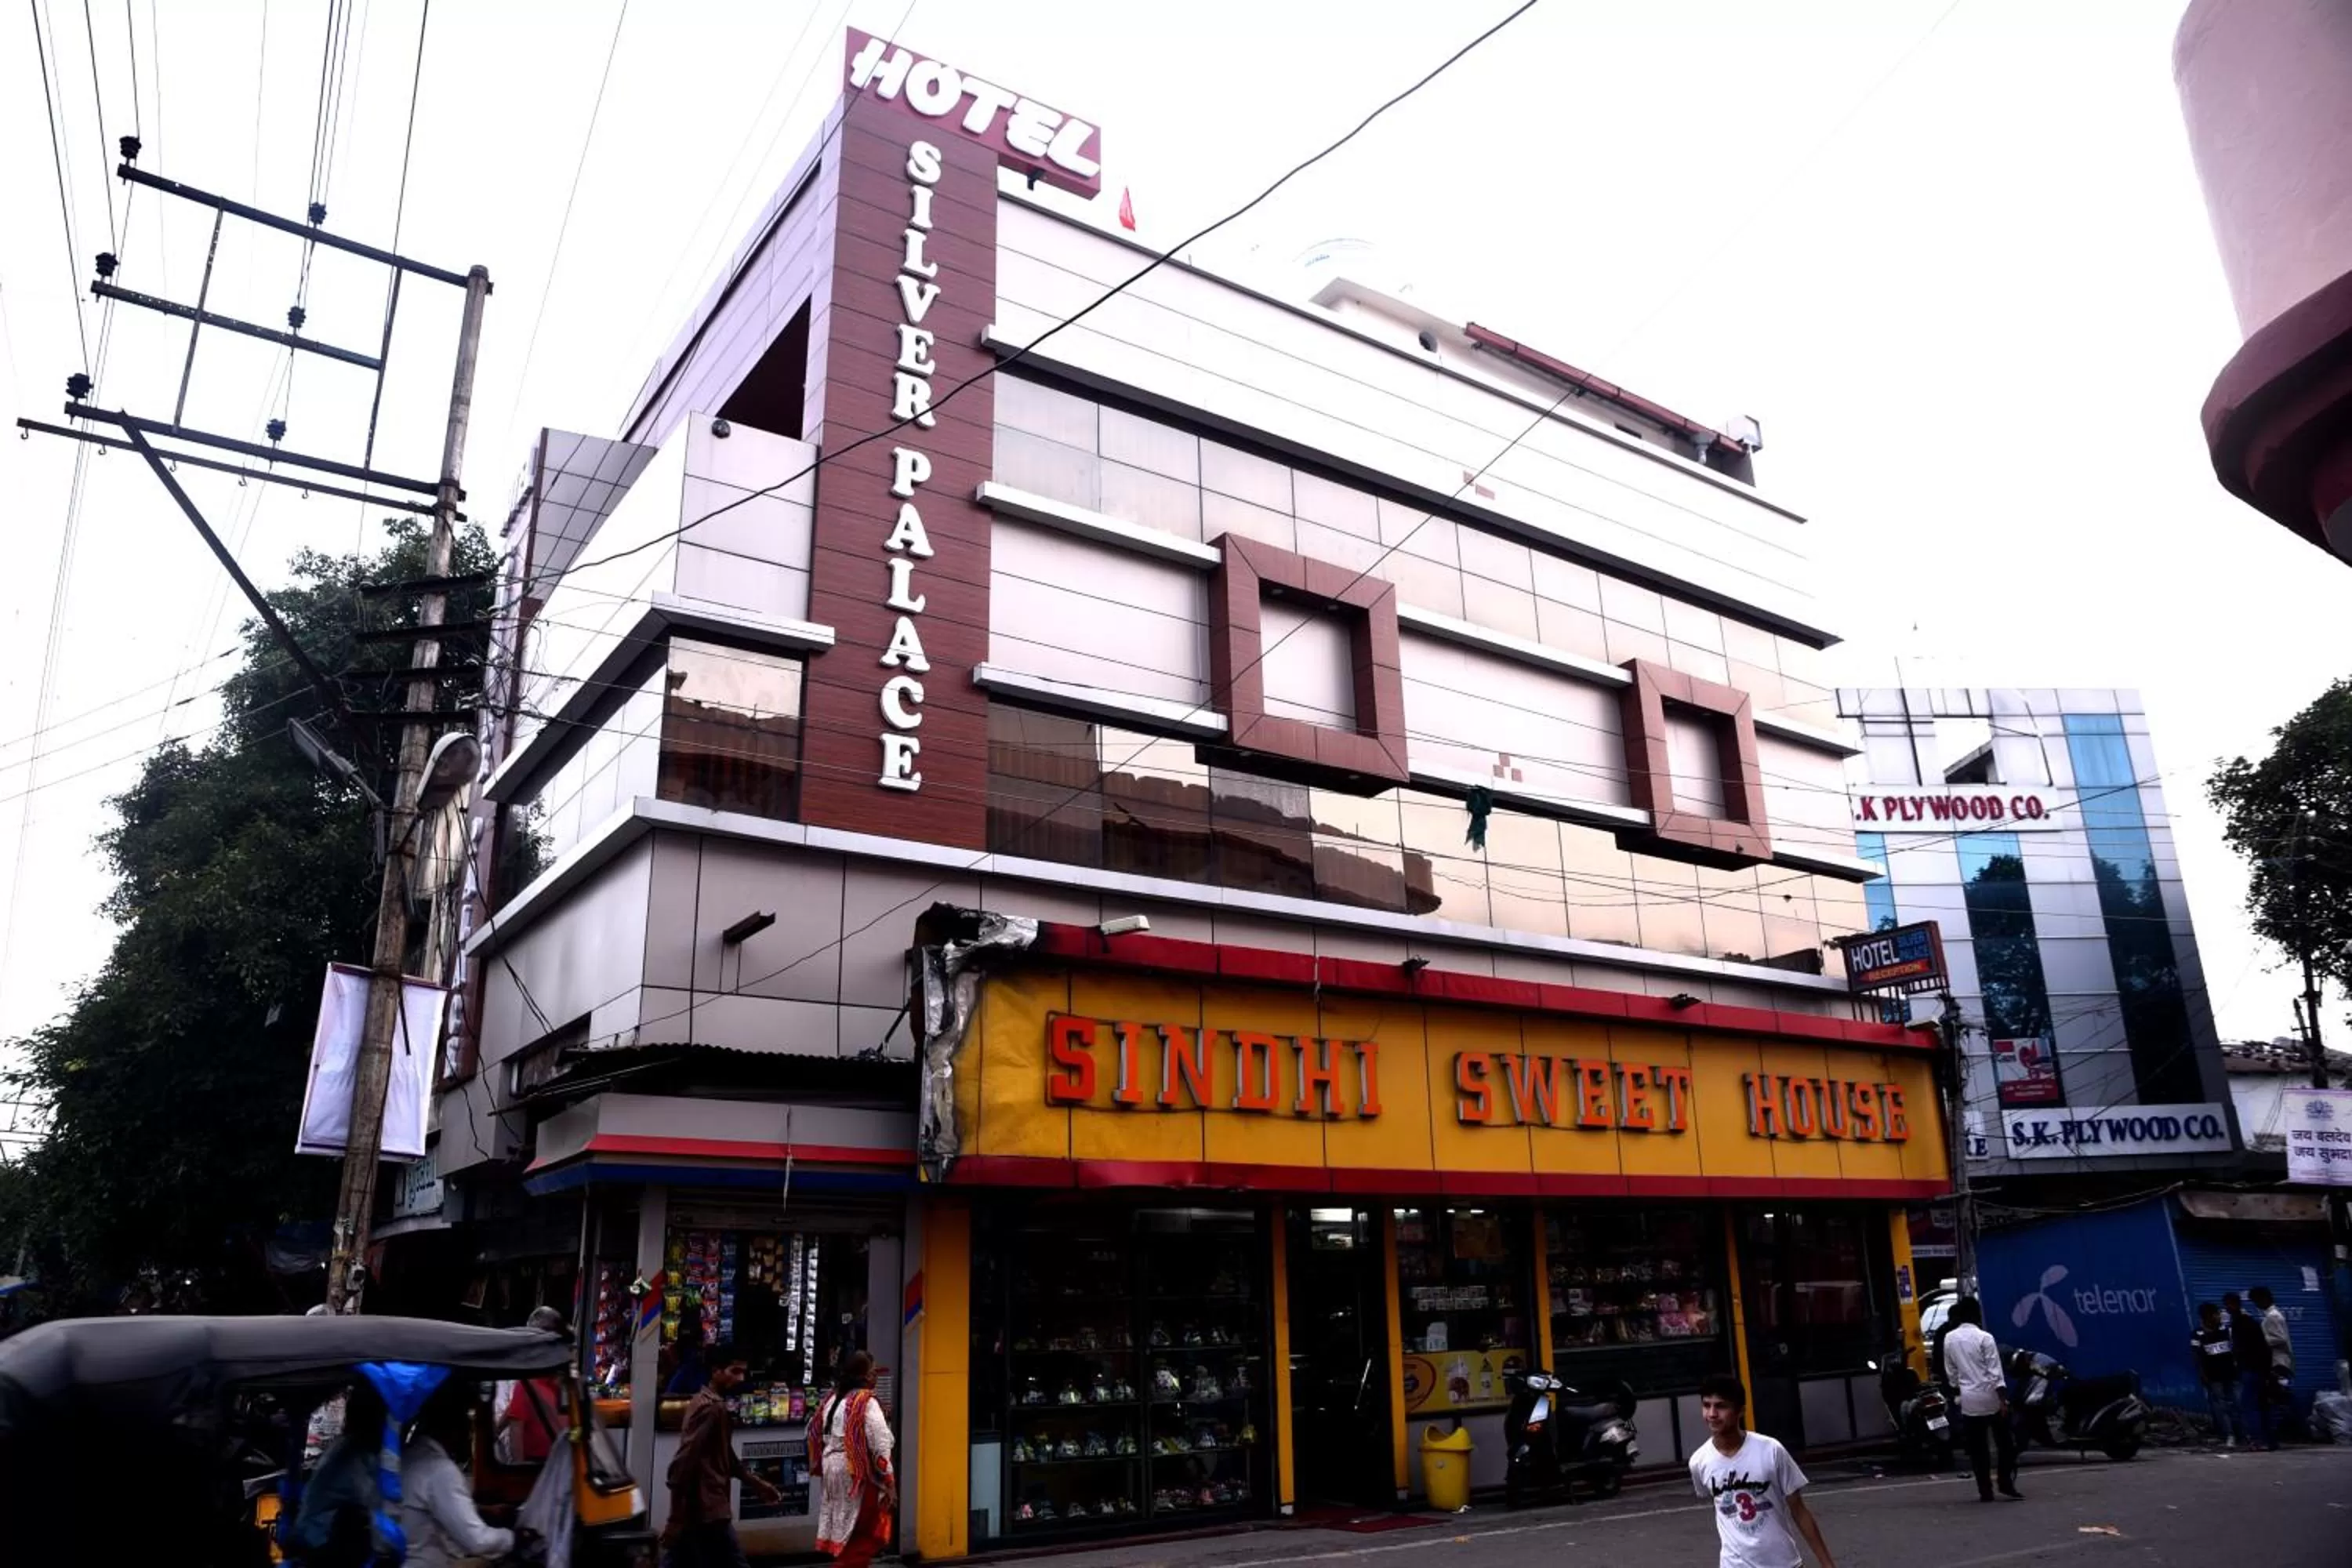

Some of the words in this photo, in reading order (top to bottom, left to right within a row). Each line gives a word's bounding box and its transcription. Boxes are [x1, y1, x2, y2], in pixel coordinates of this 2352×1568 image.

[850, 37, 1101, 177] HOTEL
[891, 140, 942, 428] SILVER
[879, 446, 935, 792] PALACE
[1882, 795, 2004, 822] PLYWOOD
[2010, 794, 2049, 820] CO.
[1851, 938, 1900, 973] HOTEL
[1051, 1016, 1381, 1117] SINDHI
[1454, 1052, 1692, 1133] SWEET
[1743, 1072, 1910, 1143] HOUSE
[2061, 1116, 2181, 1145] PLYWOOD
[2183, 1114, 2224, 1138] CO.
[2074, 1284, 2157, 1315] telenor
[1735, 1492, 1756, 1522] 3
